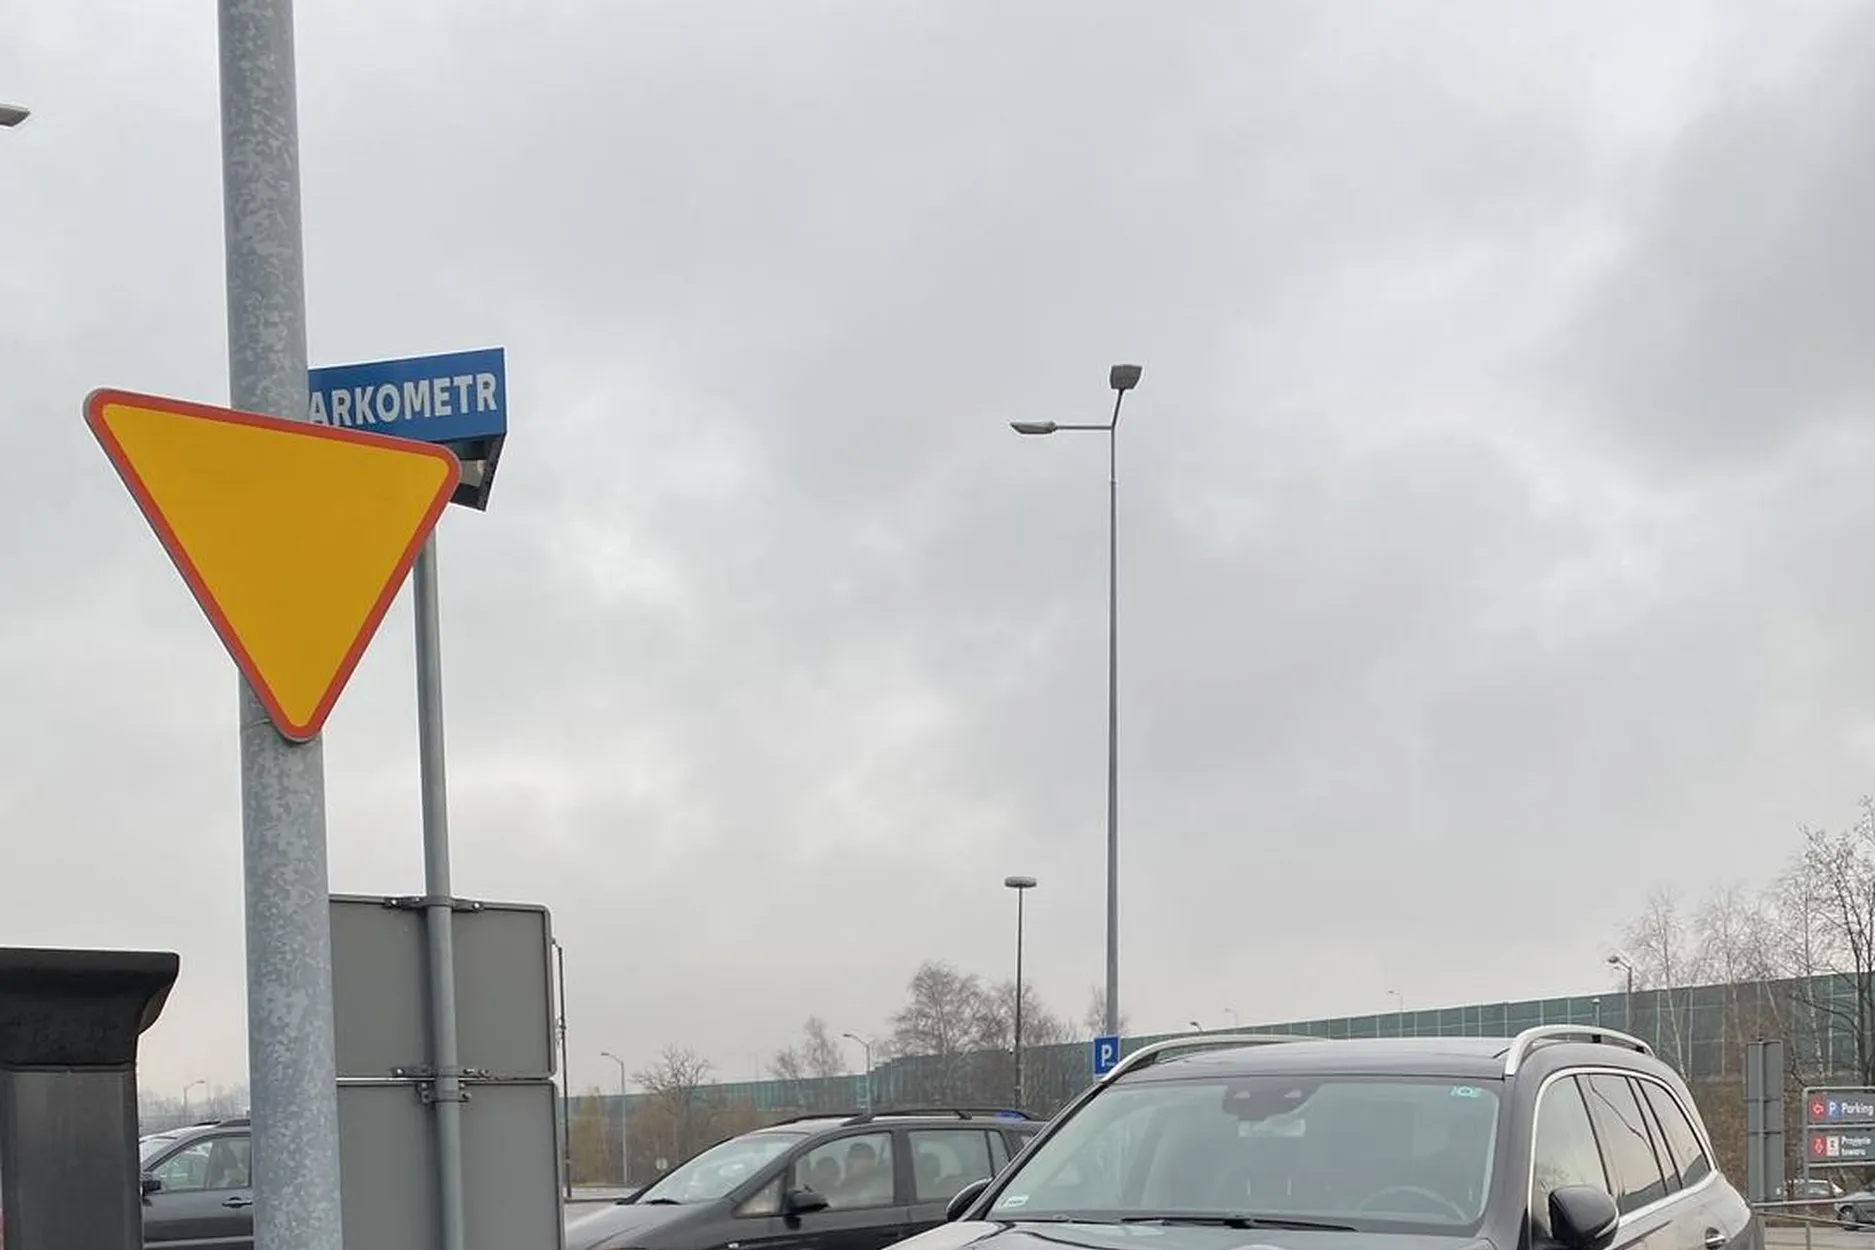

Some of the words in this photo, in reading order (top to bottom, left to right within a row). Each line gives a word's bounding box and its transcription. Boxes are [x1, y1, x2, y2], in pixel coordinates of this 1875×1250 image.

[309, 372, 498, 427] ARKOMETR
[1101, 1044, 1112, 1067] P
[1841, 1102, 1874, 1116] Parking
